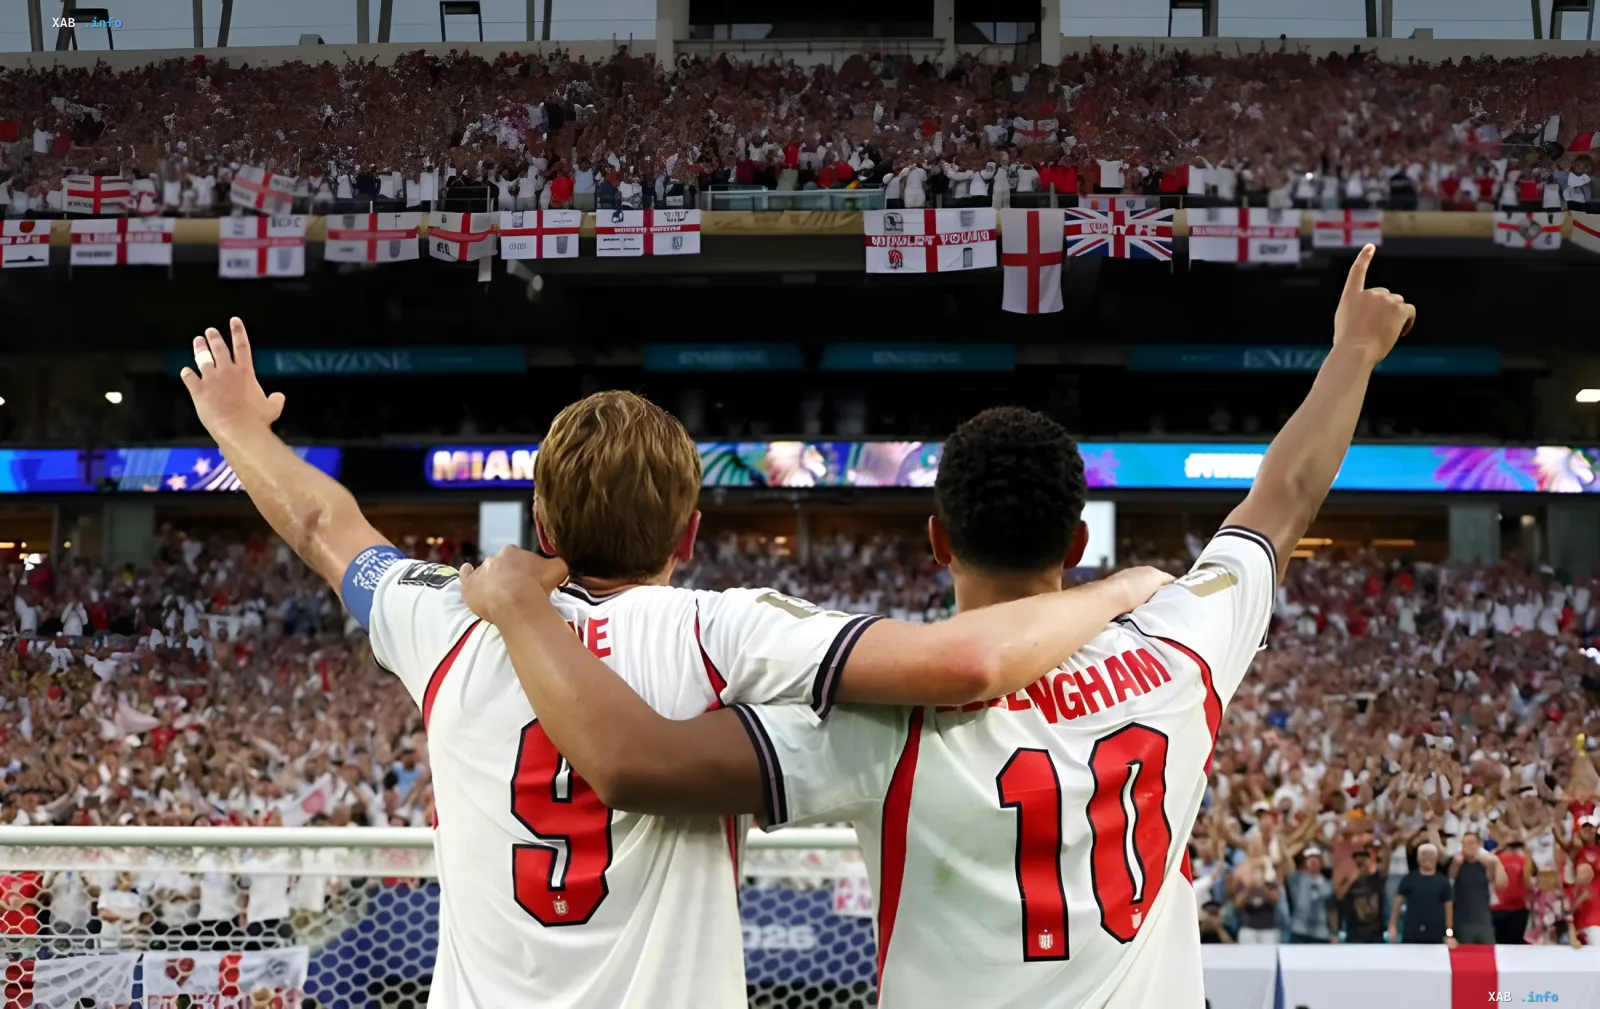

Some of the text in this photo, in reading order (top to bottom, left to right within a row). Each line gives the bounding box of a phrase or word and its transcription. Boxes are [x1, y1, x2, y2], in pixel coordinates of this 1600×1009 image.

[275, 349, 412, 372] ENDZONE
[432, 450, 538, 481] MIAM
[511, 717, 613, 927] 9
[996, 722, 1172, 962] 10
[742, 924, 817, 950] 026
